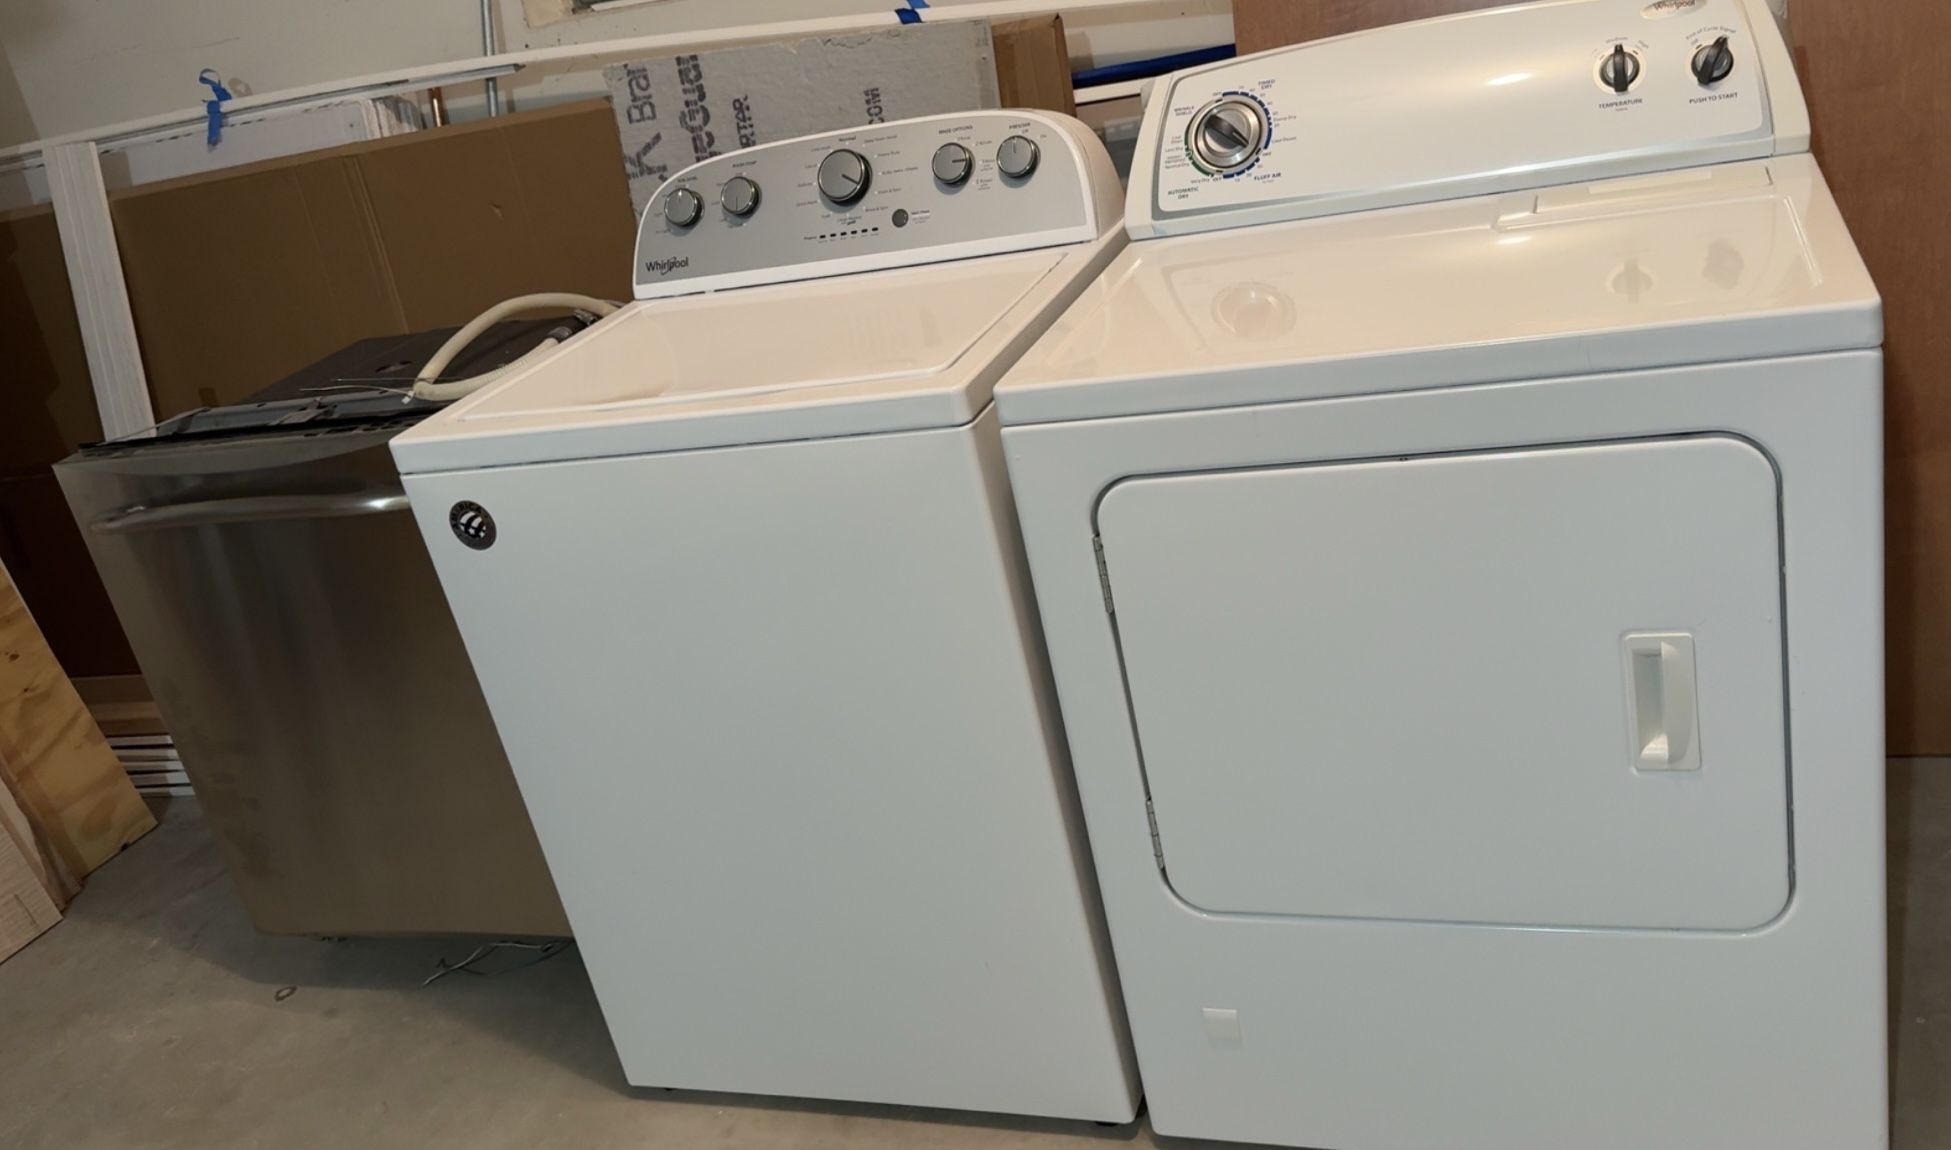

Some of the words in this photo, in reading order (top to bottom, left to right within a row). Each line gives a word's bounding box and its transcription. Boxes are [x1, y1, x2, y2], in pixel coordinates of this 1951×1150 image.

[1598, 98, 1643, 109] TEMPERATURE
[1689, 96, 1707, 104] PUSH
[1717, 92, 1738, 101] START
[1167, 186, 1199, 195] AUTOMATIC
[645, 256, 689, 275] Whirlpool
